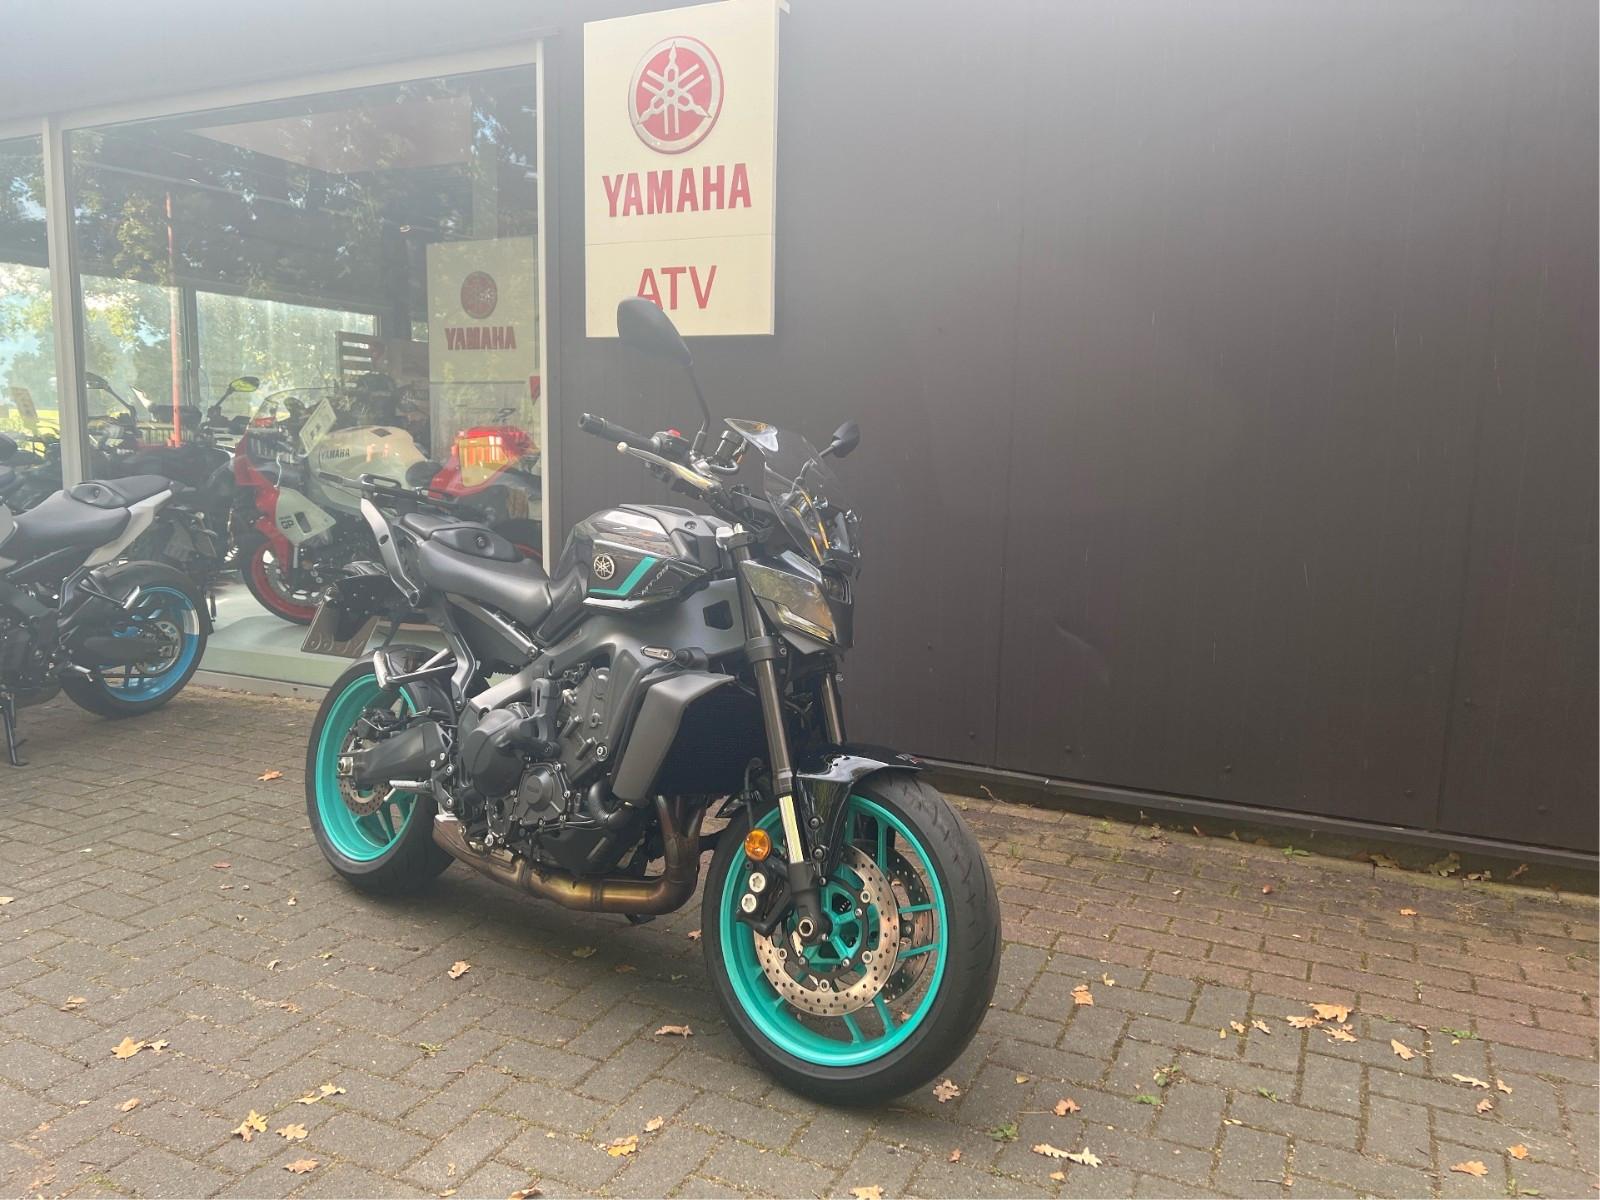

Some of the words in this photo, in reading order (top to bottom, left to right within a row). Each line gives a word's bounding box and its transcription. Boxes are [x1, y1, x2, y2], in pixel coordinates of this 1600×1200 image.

[602, 163, 752, 217] YAMAHA
[636, 265, 717, 311] ATV
[445, 326, 517, 351] YAMAHA
[321, 448, 350, 460] YAMAHA
